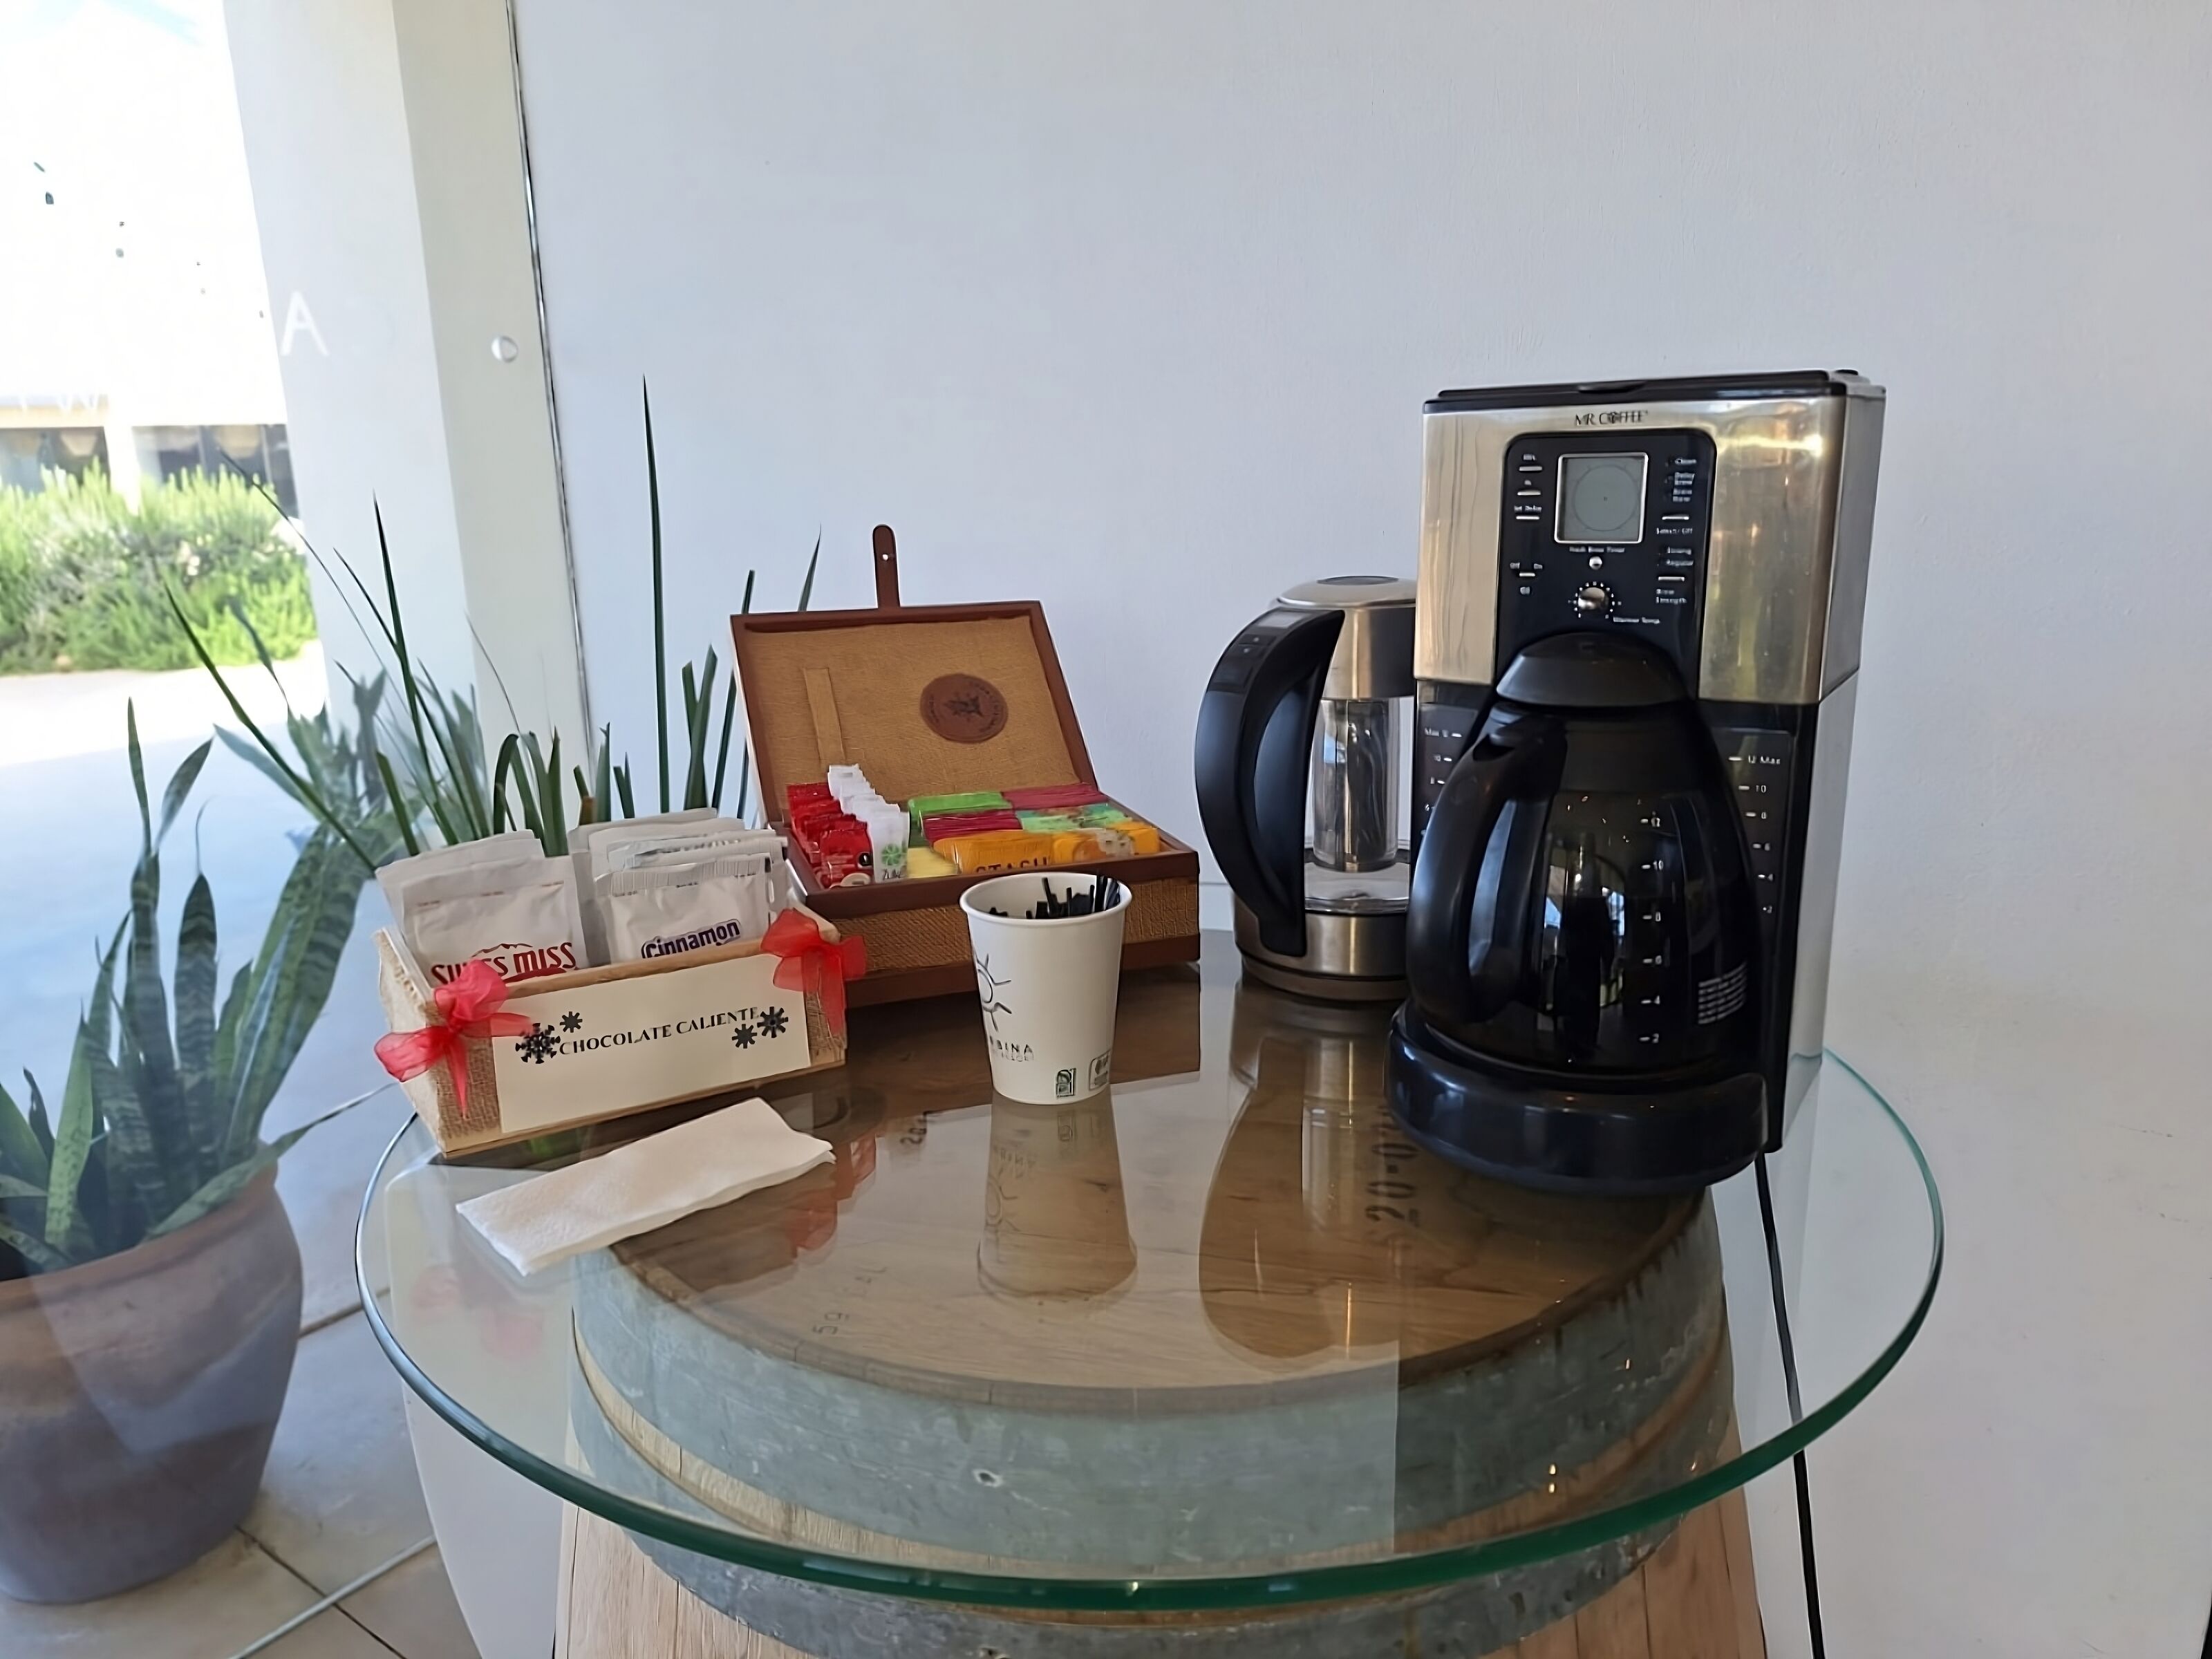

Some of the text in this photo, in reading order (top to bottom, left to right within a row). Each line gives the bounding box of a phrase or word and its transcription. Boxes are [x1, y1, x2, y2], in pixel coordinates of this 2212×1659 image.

[513, 941, 577, 974] MISS
[644, 921, 741, 959] Cinnamon
[559, 1006, 760, 1056] CHOCOLATE CALIENTE
